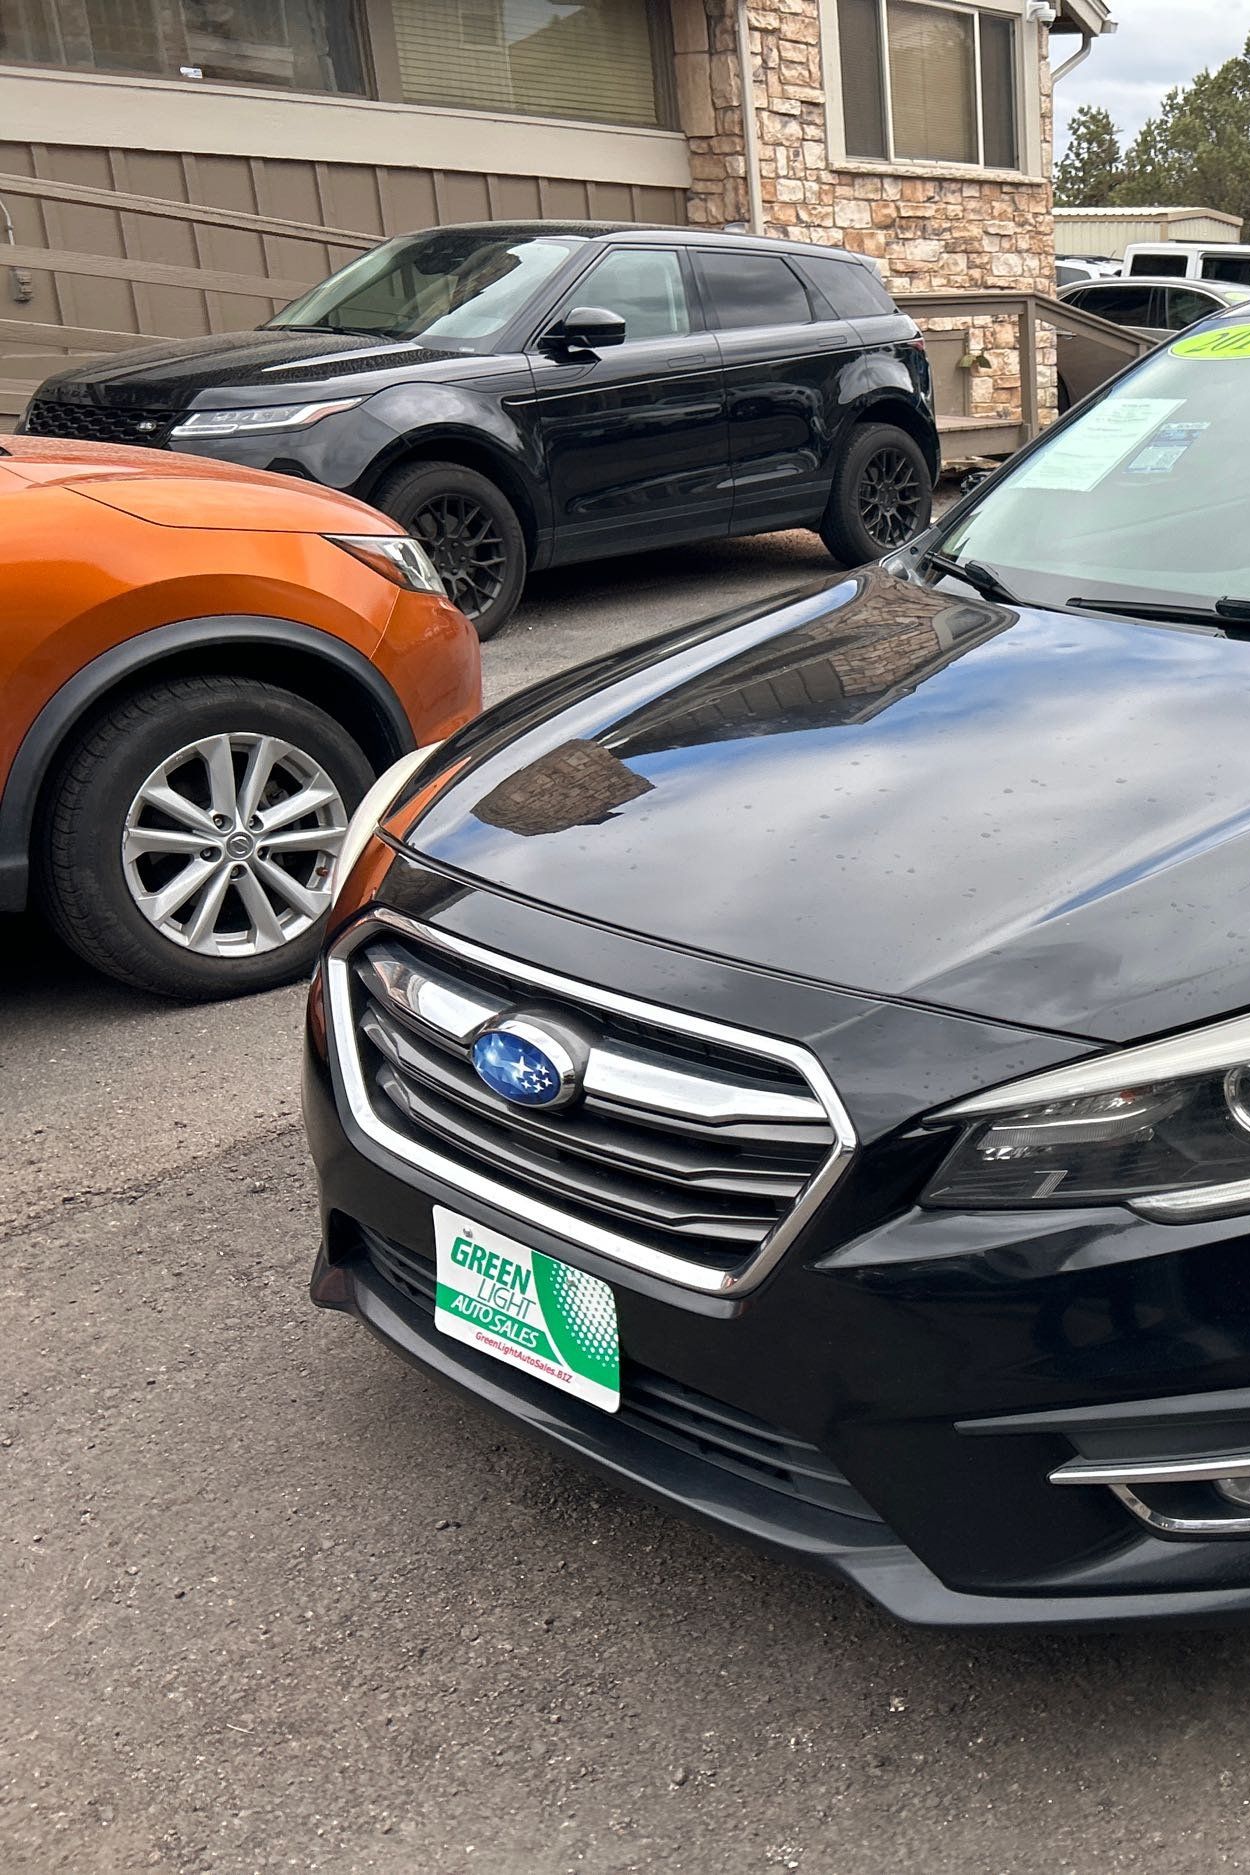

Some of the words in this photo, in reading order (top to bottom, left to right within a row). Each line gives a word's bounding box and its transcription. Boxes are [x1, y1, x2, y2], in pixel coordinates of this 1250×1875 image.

[450, 1237, 531, 1295] GREEN
[451, 1295, 493, 1323] AUTO
[489, 1315, 539, 1348] SALES
[477, 1278, 536, 1320] LIGHT
[475, 1331, 573, 1384] GreenLightAutoSales.BIZ
